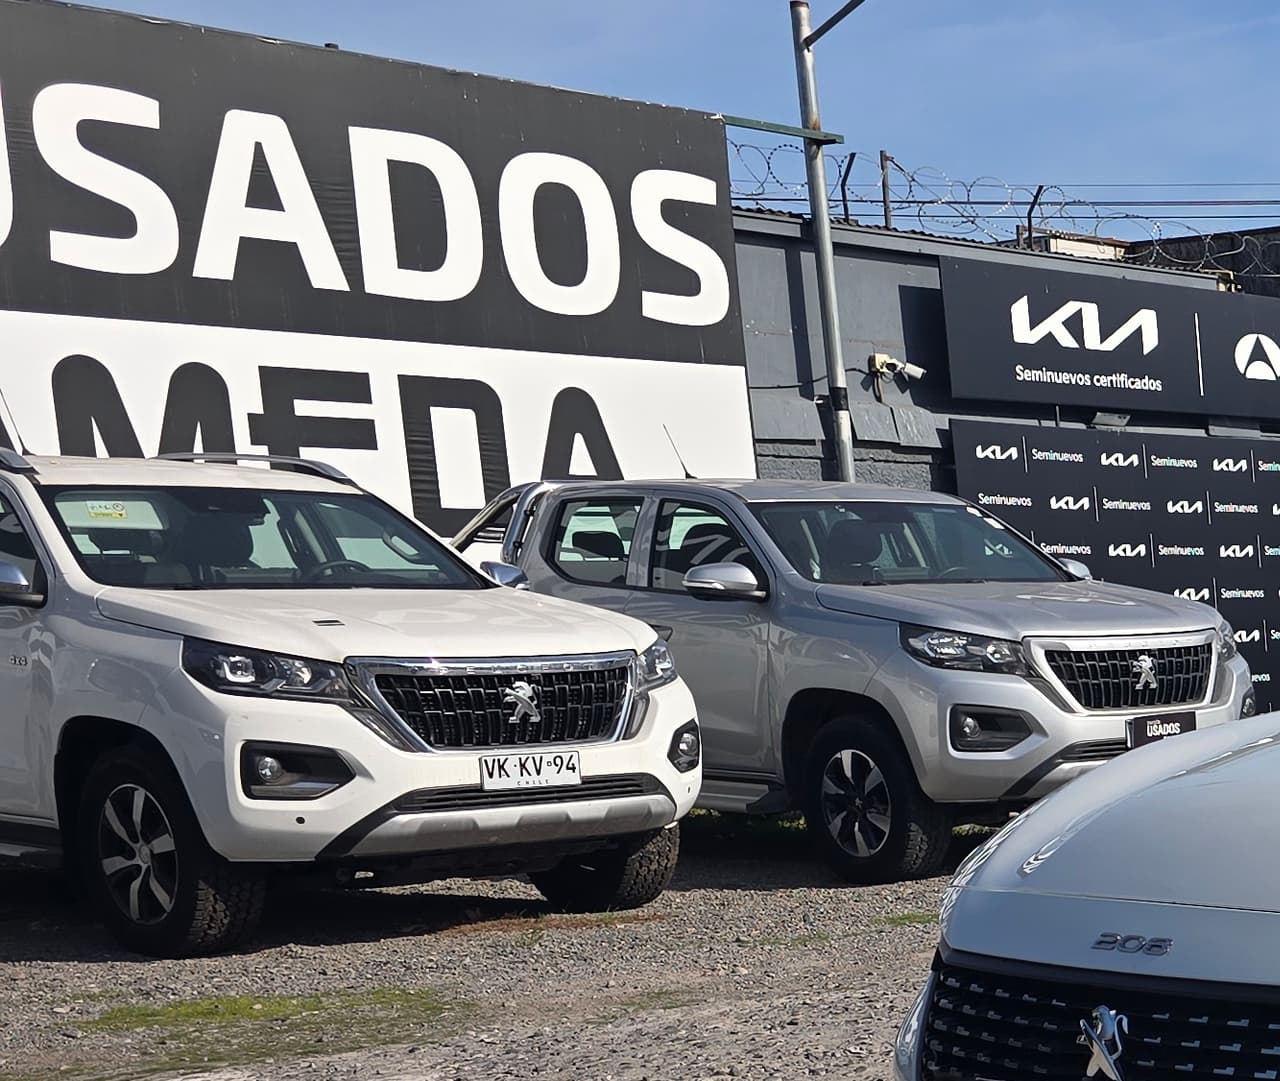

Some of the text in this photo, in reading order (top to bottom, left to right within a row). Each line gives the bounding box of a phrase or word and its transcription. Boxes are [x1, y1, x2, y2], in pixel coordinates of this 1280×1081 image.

[0, 82, 730, 328] SADOS
[1010, 295, 1158, 356] KIA
[1015, 364, 1163, 393] Seminuevos certificados
[1032, 449, 1083, 462] Seminuevos
[1151, 455, 1197, 468] Seminuevos
[978, 493, 1032, 507] Seminuevos
[1103, 498, 1150, 510] Seminuevos
[1215, 502, 1258, 513] Seminuevos
[1041, 543, 1091, 554] Seminuevos
[1159, 545, 1204, 555] Seminuevos
[1221, 588, 1264, 598] Seminuevos
[1146, 722, 1181, 737] USADOS
[1090, 931, 1175, 956] 208
